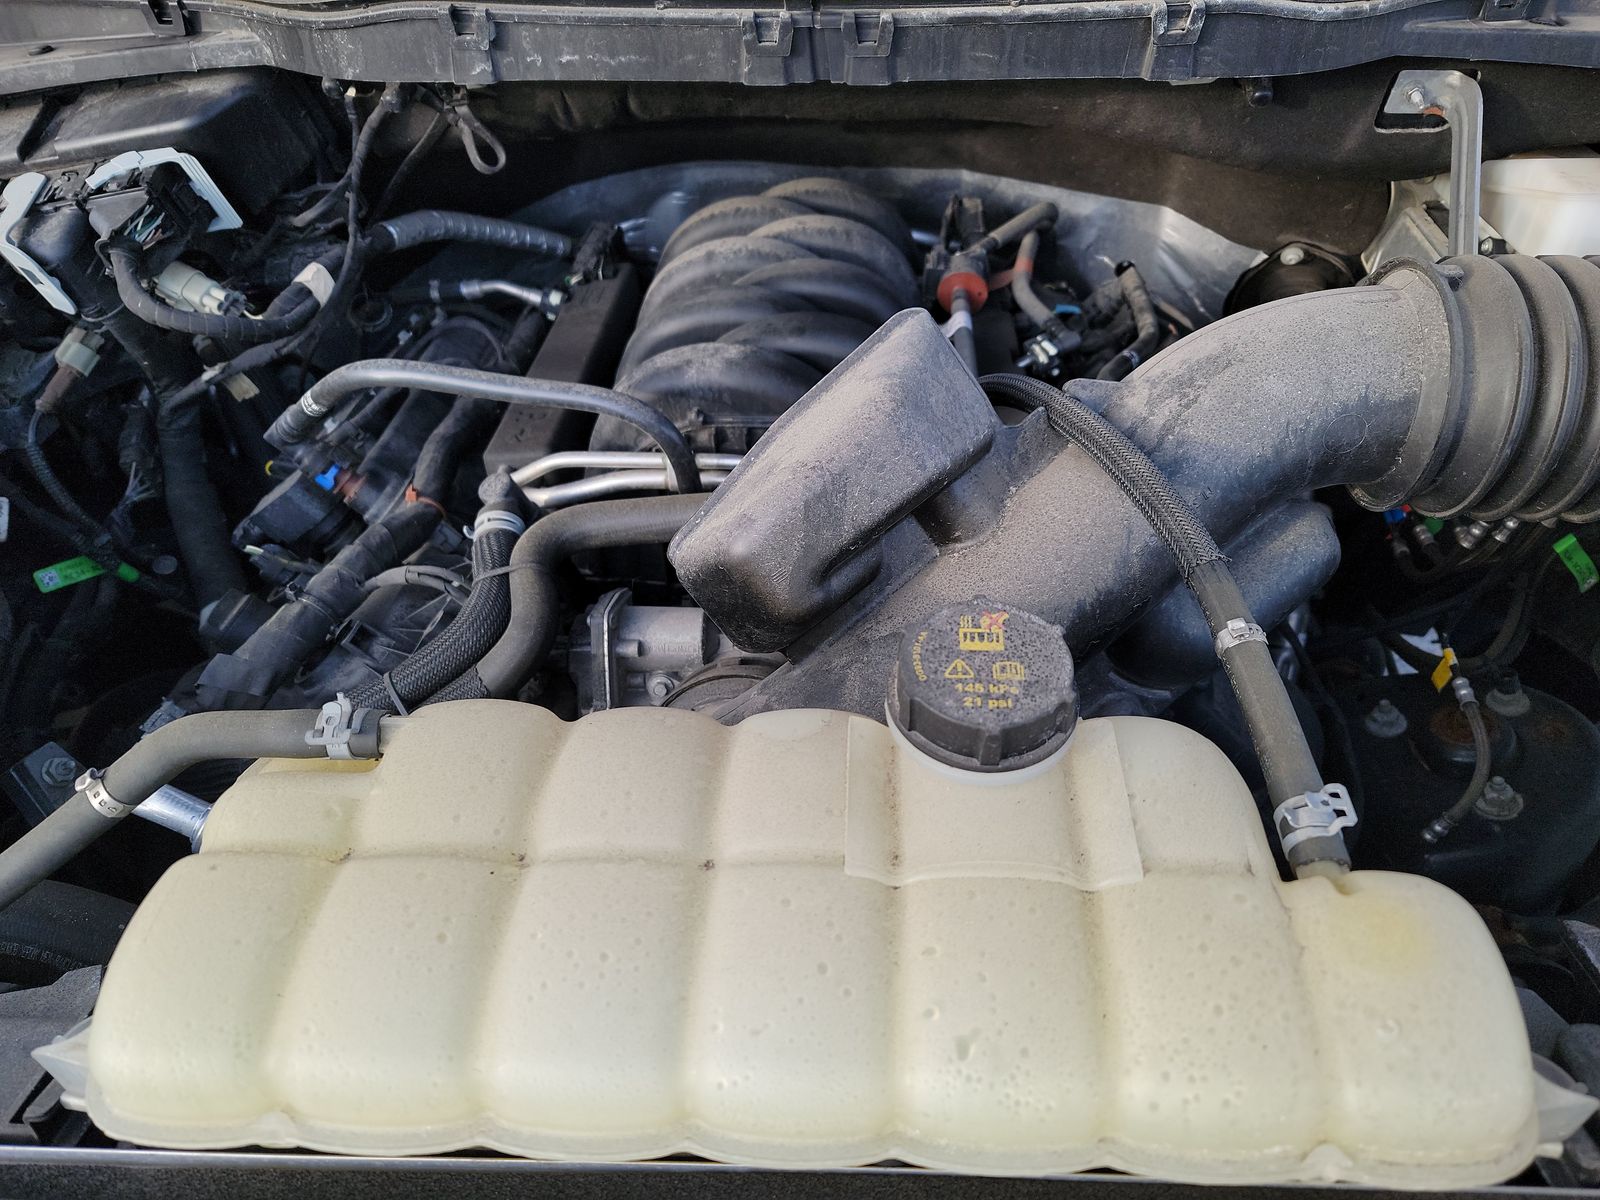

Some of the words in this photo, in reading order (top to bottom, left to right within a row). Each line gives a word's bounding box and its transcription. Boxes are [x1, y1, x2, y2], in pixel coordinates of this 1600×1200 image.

[988, 683, 1019, 694] kPa
[962, 696, 982, 707] 21
[988, 697, 1013, 710] psi
